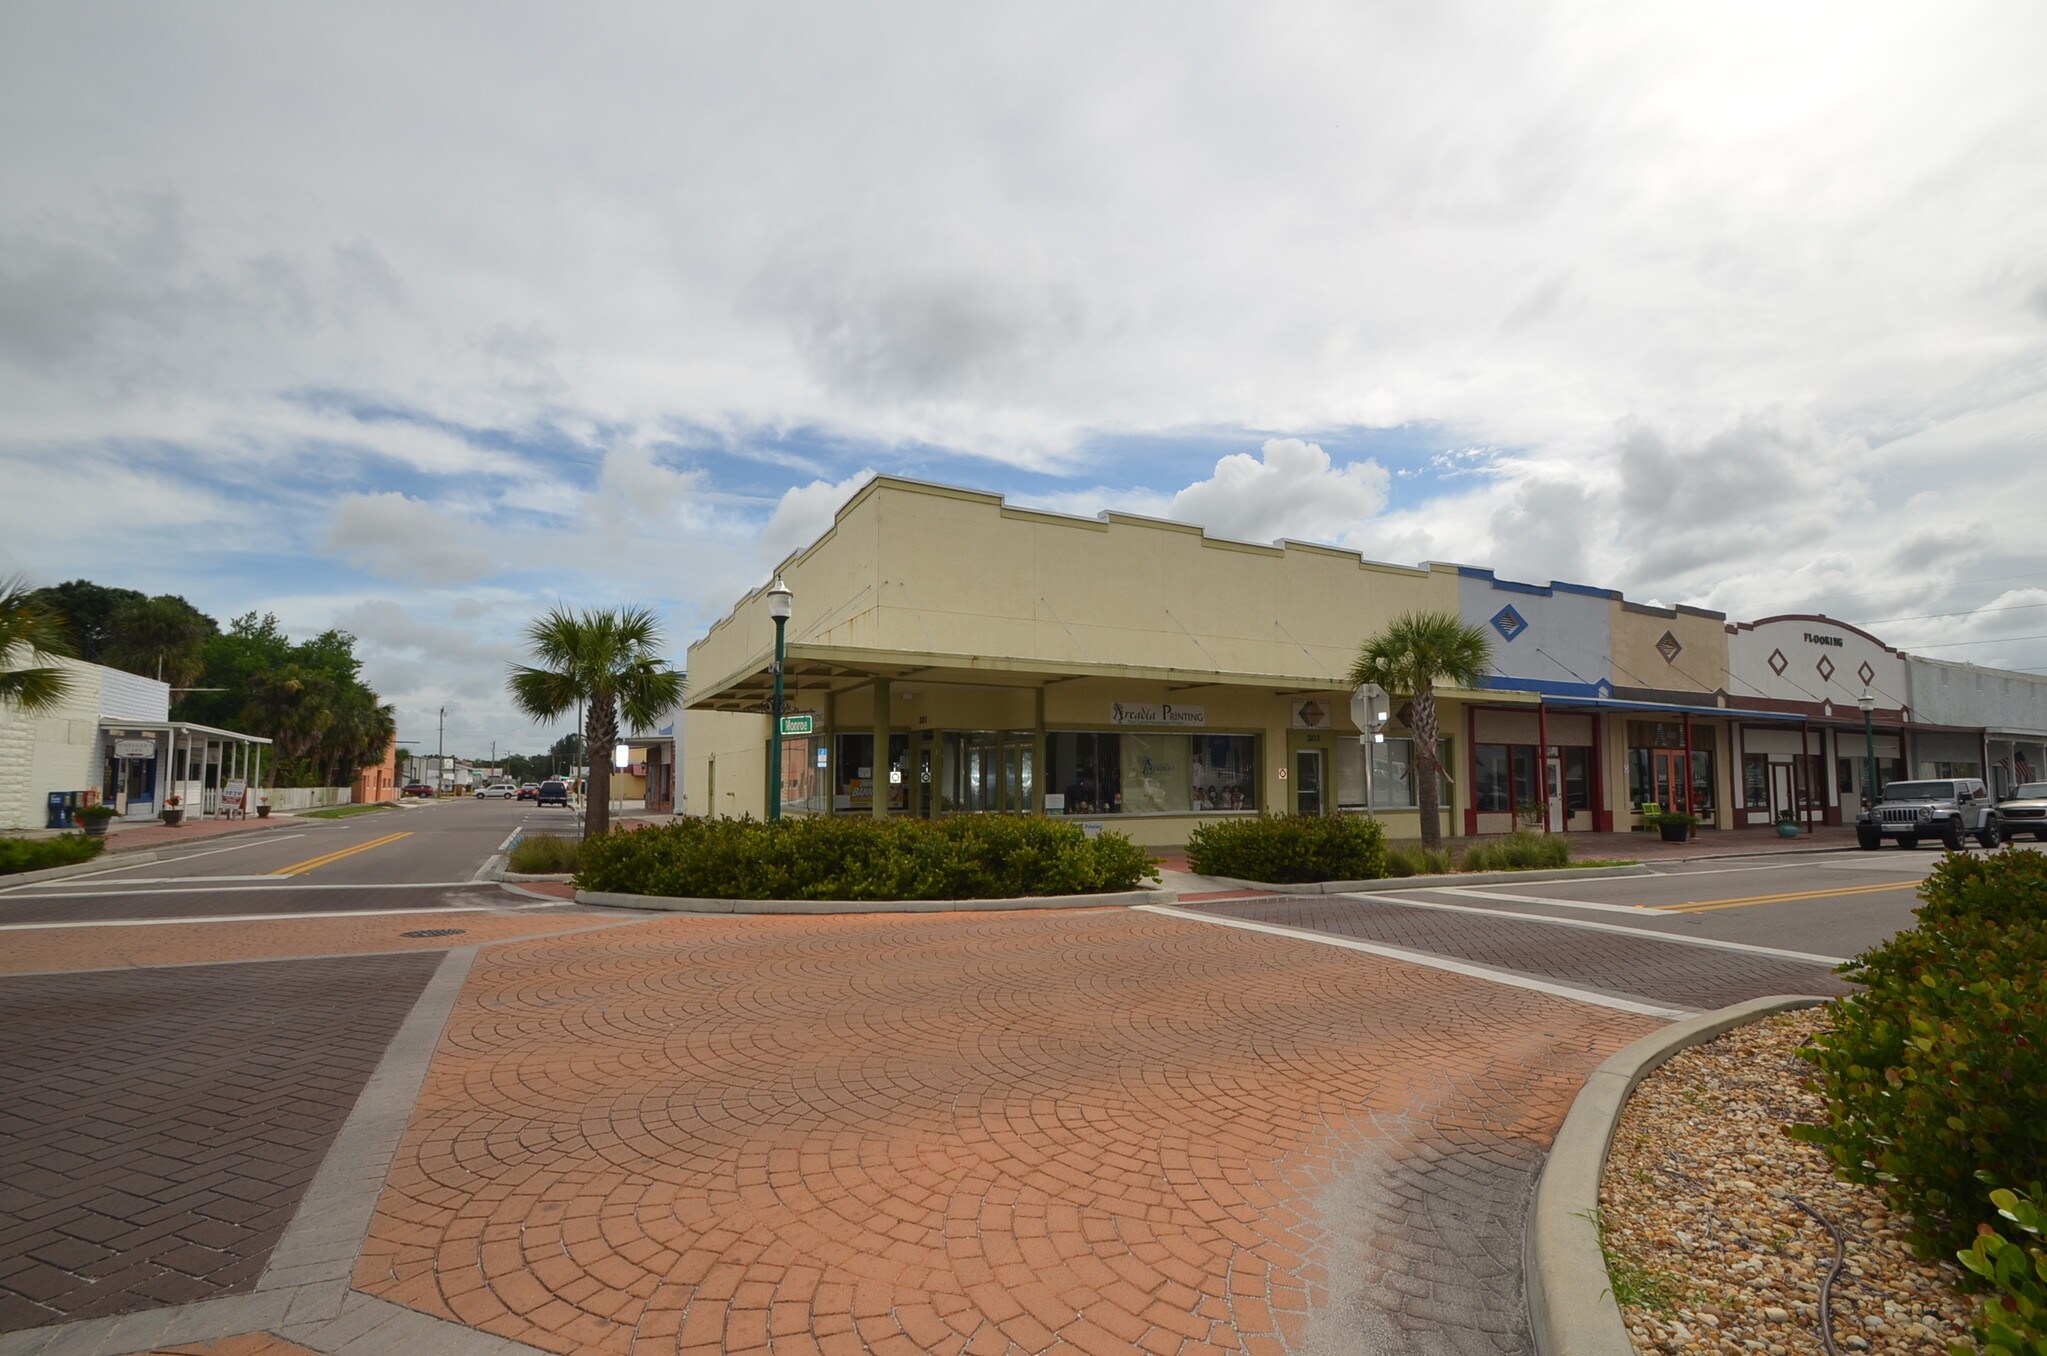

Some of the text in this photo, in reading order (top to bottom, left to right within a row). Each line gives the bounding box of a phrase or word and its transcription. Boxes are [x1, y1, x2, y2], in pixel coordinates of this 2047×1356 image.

[1803, 632, 1843, 648] FLOORING
[1113, 702, 1204, 723] Arcadia PRINTING
[785, 719, 808, 731] Monroe
[1307, 734, 1321, 743] 203
